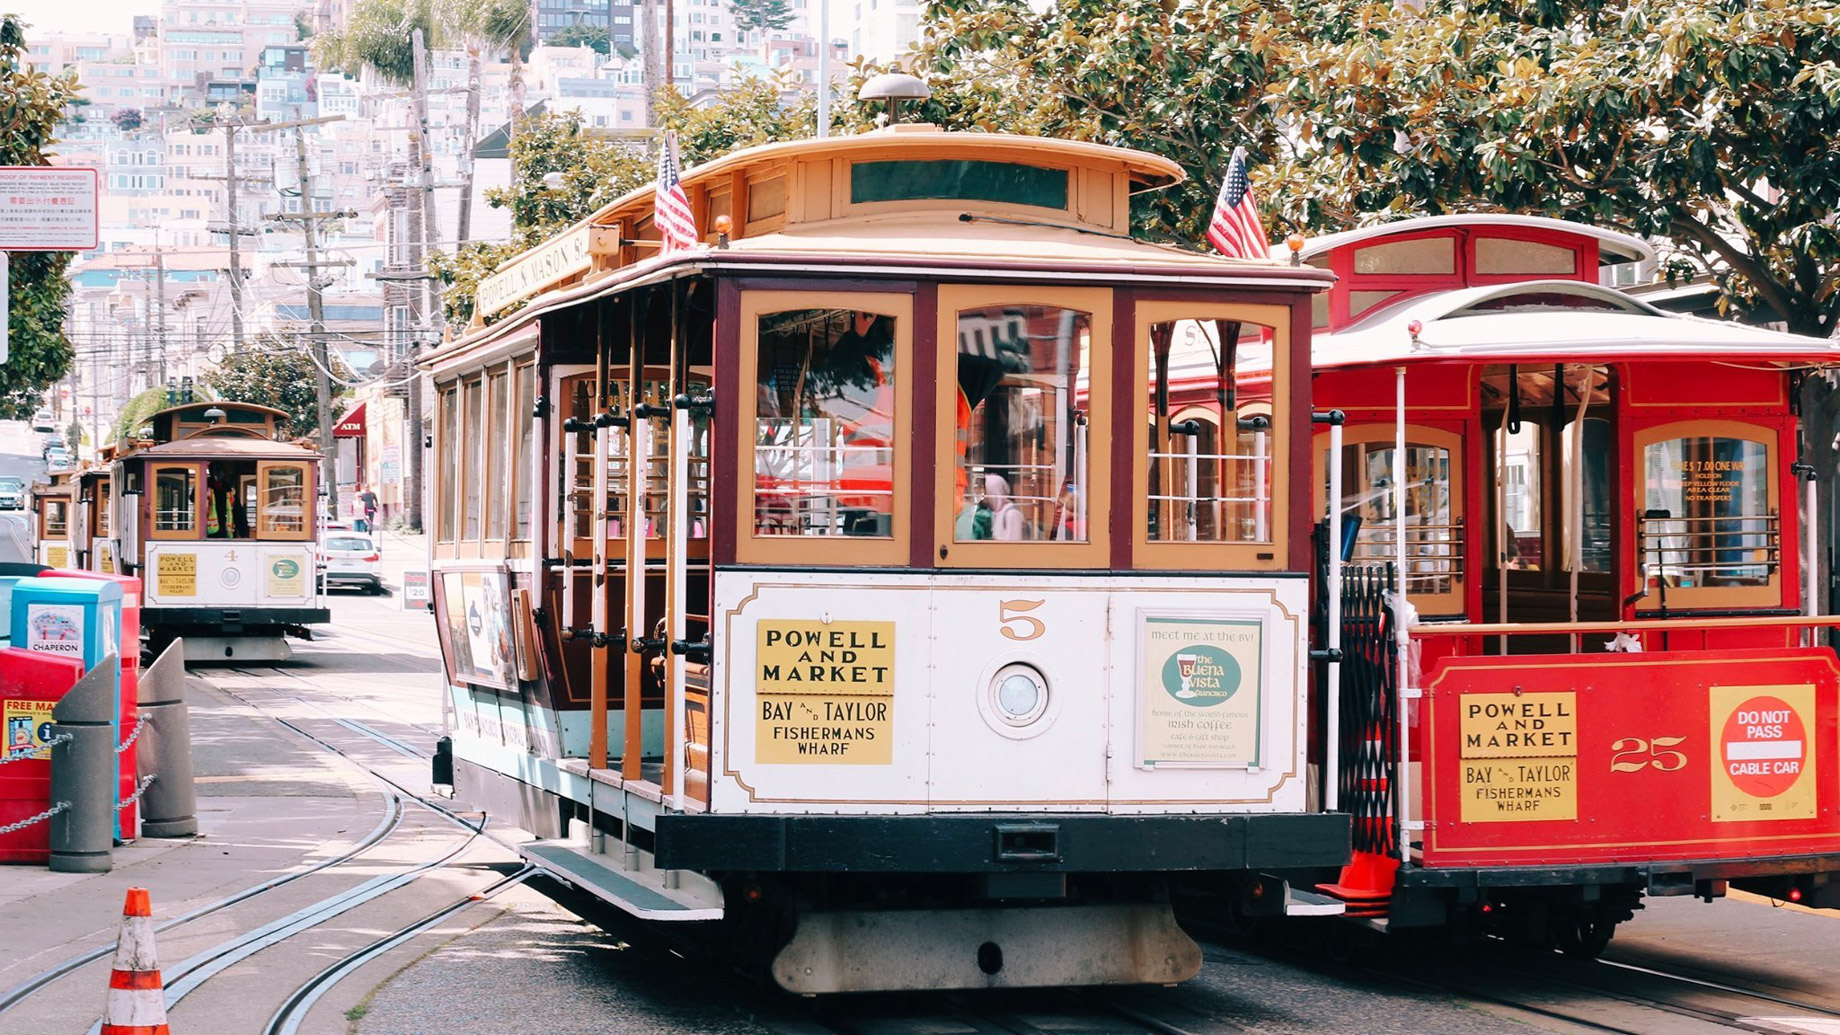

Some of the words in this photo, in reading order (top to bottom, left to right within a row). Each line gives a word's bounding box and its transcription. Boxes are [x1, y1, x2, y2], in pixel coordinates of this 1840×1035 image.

[1715, 461, 1731, 471] ONE
[224, 550, 238, 562] 4
[1000, 599, 1046, 641] 5
[766, 630, 886, 648] POWELL
[33, 644, 78, 652] CHAPERON
[798, 650, 857, 663] AND
[763, 665, 888, 682] MARKET
[7, 701, 31, 710] FREE
[762, 702, 792, 720] BAY
[800, 702, 818, 720] AND
[824, 702, 887, 721] TAYLOR
[1469, 703, 1569, 718] POWELL
[1738, 711, 1758, 725] DO
[1761, 710, 1791, 724] NOT
[1496, 720, 1544, 730] AND
[1747, 725, 1783, 739] PASS
[773, 727, 875, 740] FISHERMANS
[1467, 732, 1571, 747] MARKET
[798, 742, 850, 755] WHARF
[1610, 736, 1688, 773] 25
[1466, 767, 1492, 783] BAY
[1518, 765, 1570, 782] TAYLOR
[1730, 762, 1770, 776] CABLE
[1773, 761, 1799, 774] CAR
[1476, 787, 1561, 799] FISHERMANS
[1497, 800, 1540, 811] WHARF
